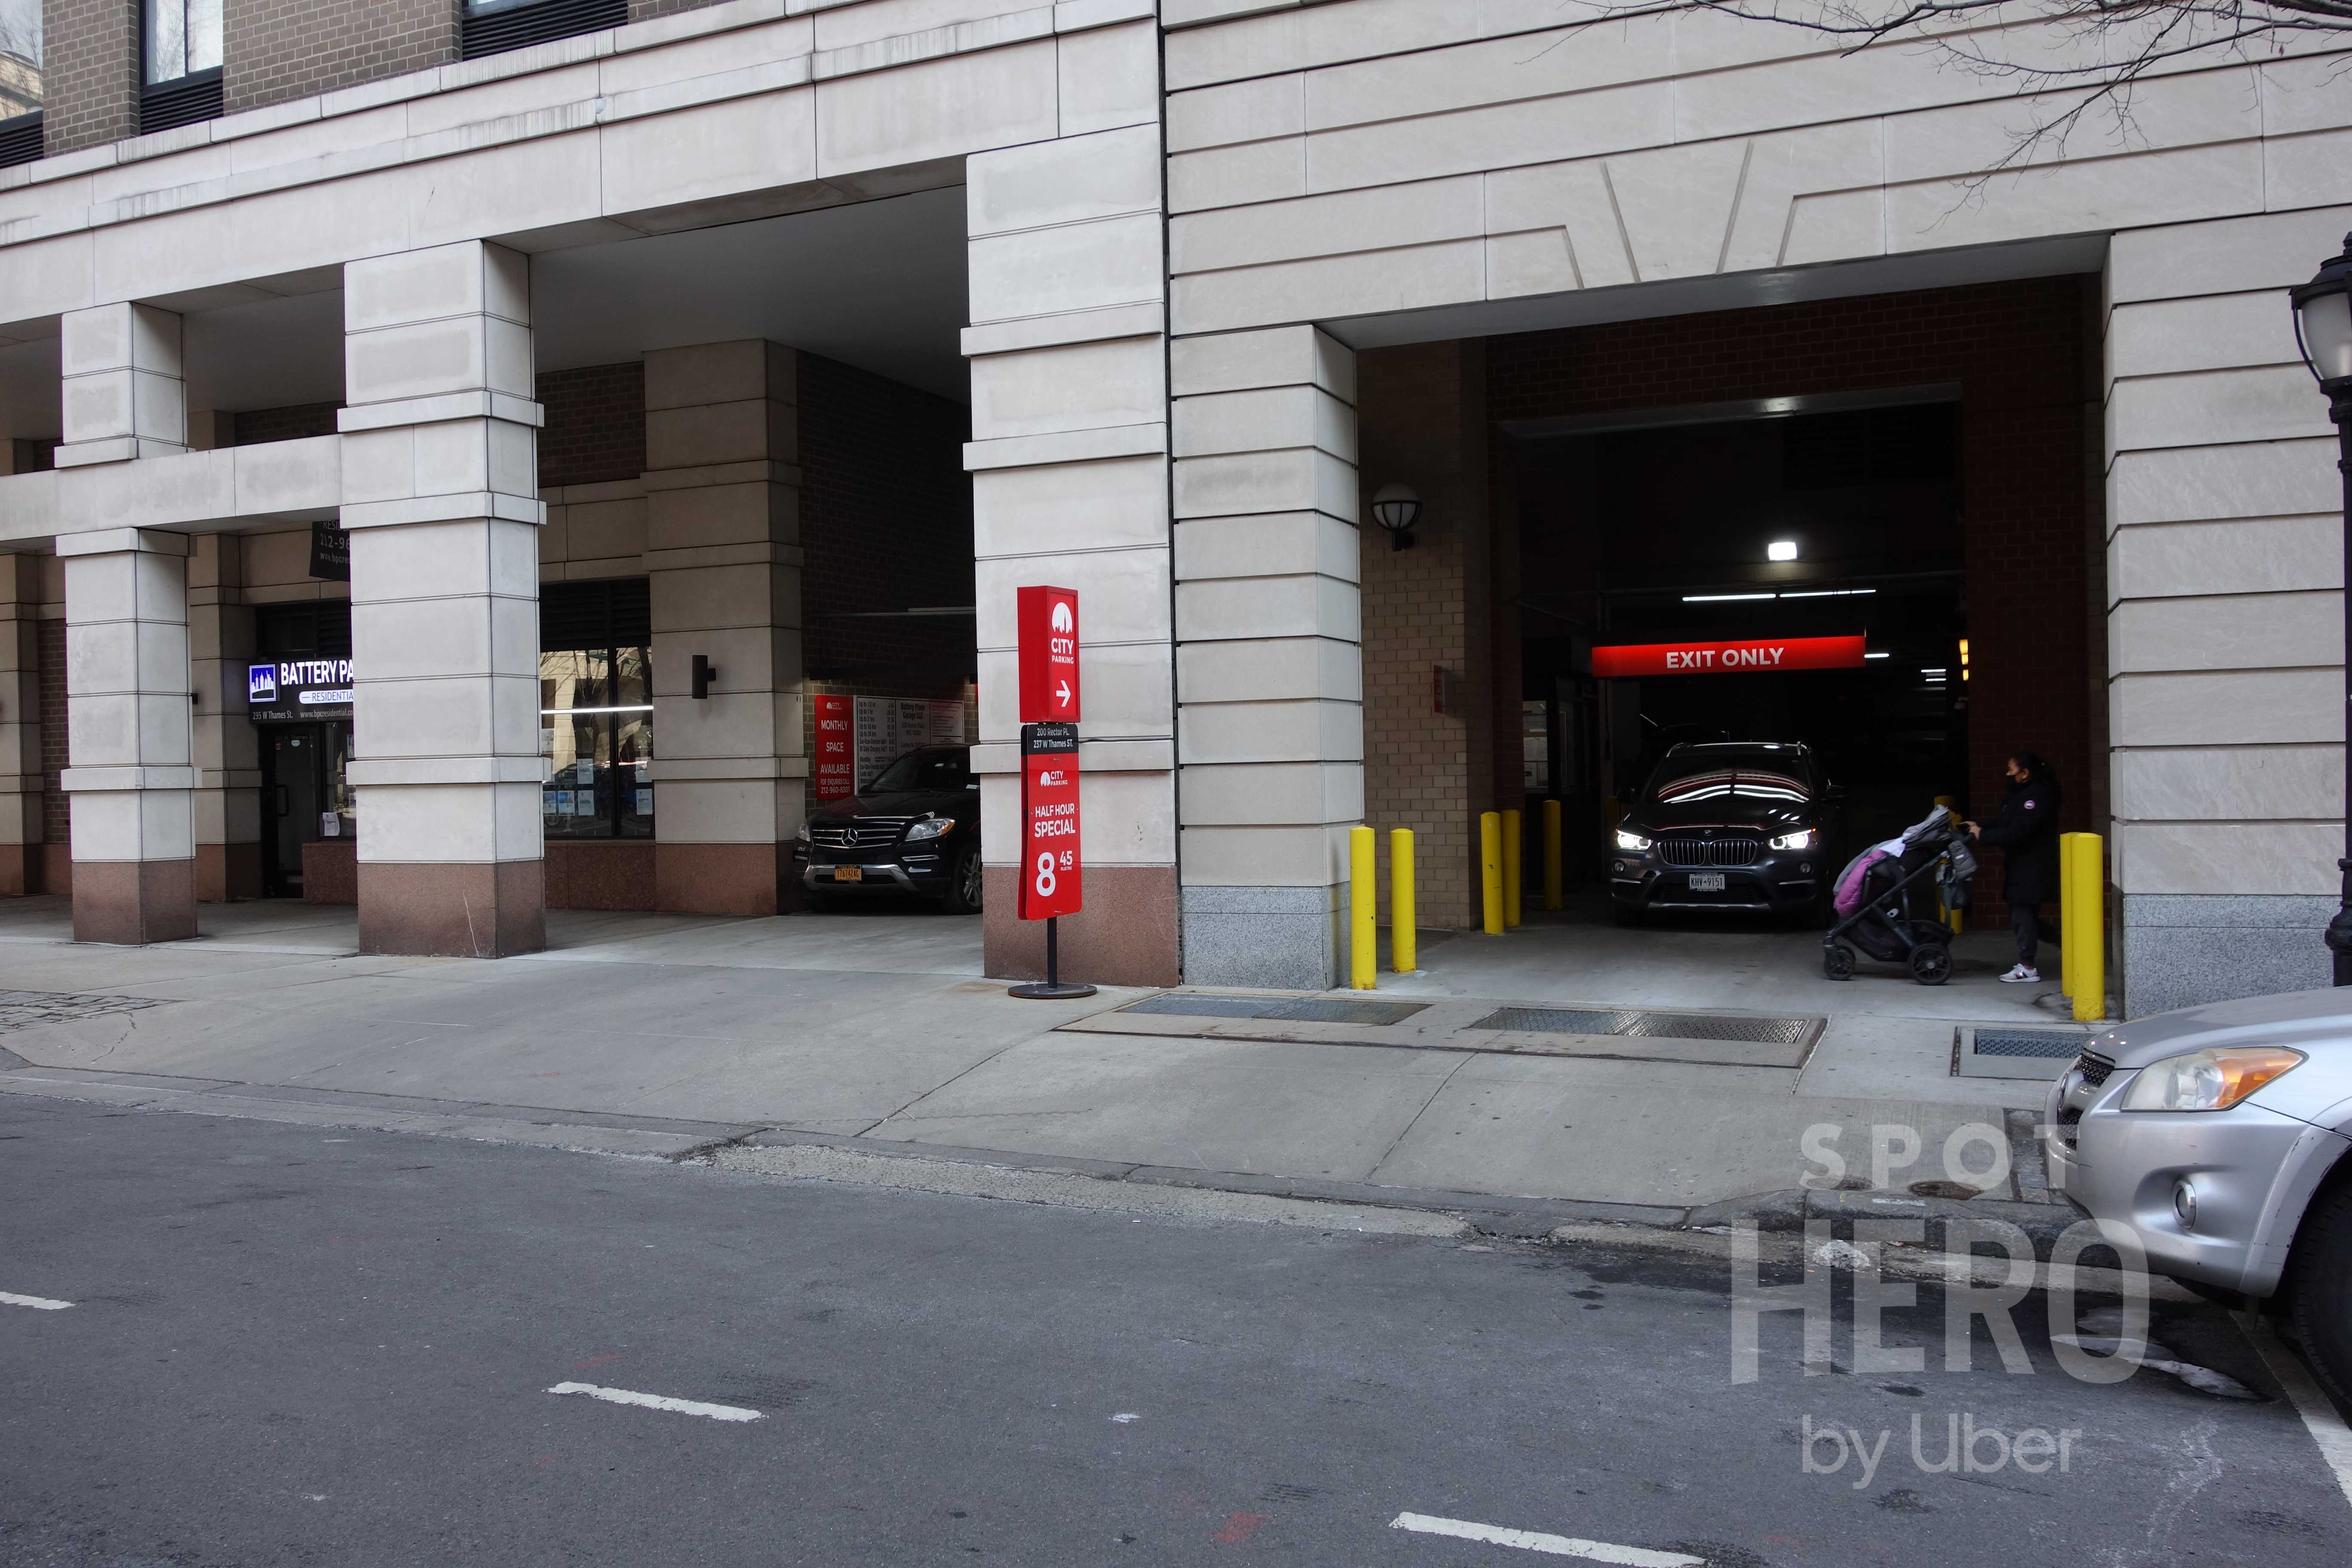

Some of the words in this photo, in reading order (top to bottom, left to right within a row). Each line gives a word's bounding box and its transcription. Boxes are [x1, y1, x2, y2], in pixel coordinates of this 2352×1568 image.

[1051, 638, 1074, 655] CITY
[1052, 655, 1074, 664] PARKING
[1666, 649, 1715, 669] EXIT
[1722, 647, 1784, 667] ONLY
[281, 660, 337, 685] BATTERY
[253, 712, 261, 720] 295
[268, 711, 285, 719] Thames
[821, 720, 848, 730] MONTHLY
[1047, 728, 1063, 736] Rector
[826, 742, 844, 752] SPACE
[1033, 740, 1041, 748] 237
[1043, 740, 1047, 748] W
[1048, 739, 1066, 747] Thames
[820, 763, 850, 774] AVAILABLE
[1050, 770, 1064, 780] CITY
[821, 786, 850, 794] 212-960-8301
[1035, 805, 1054, 818] HALF
[1055, 803, 1075, 816] HOUR
[1034, 818, 1075, 838] SPECIAL
[1036, 852, 1056, 897] 8
[1060, 850, 1073, 866] 45
